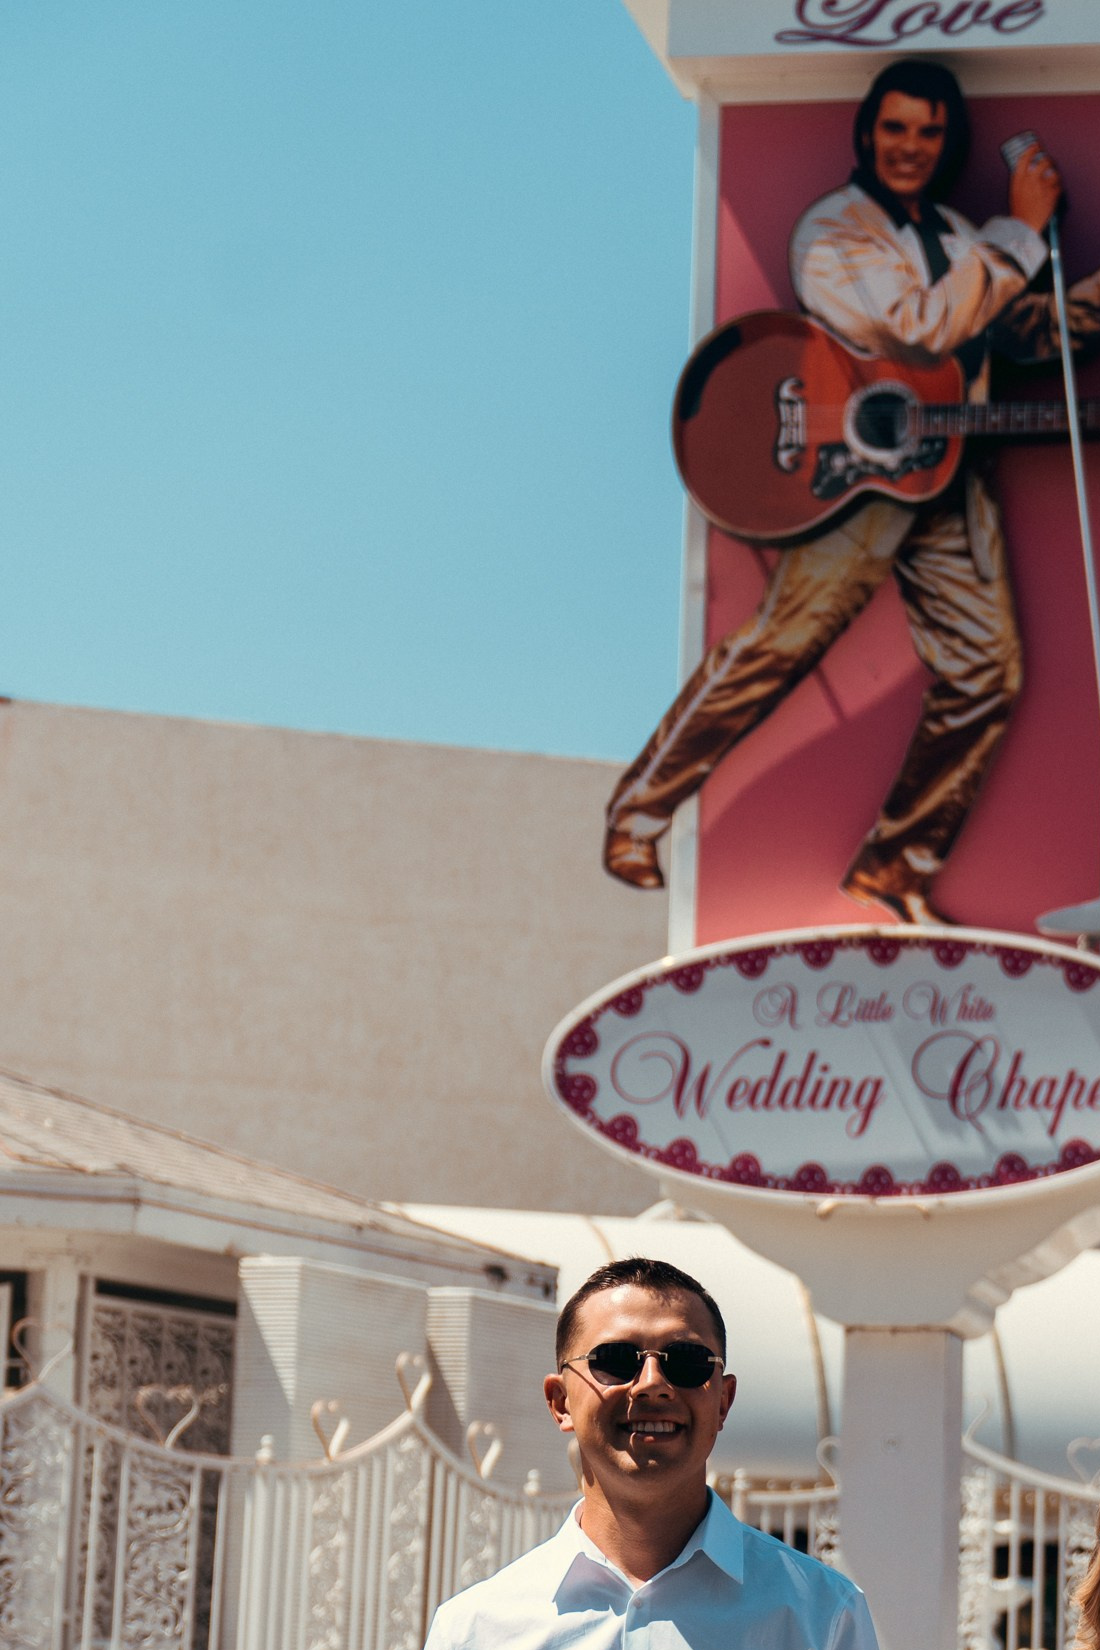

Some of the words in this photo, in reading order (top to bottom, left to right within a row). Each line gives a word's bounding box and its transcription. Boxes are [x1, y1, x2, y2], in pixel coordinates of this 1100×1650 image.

[752, 981, 802, 1031] A
[814, 980, 896, 1029] Little
[903, 979, 997, 1027] White
[610, 1030, 884, 1138] Wedding
